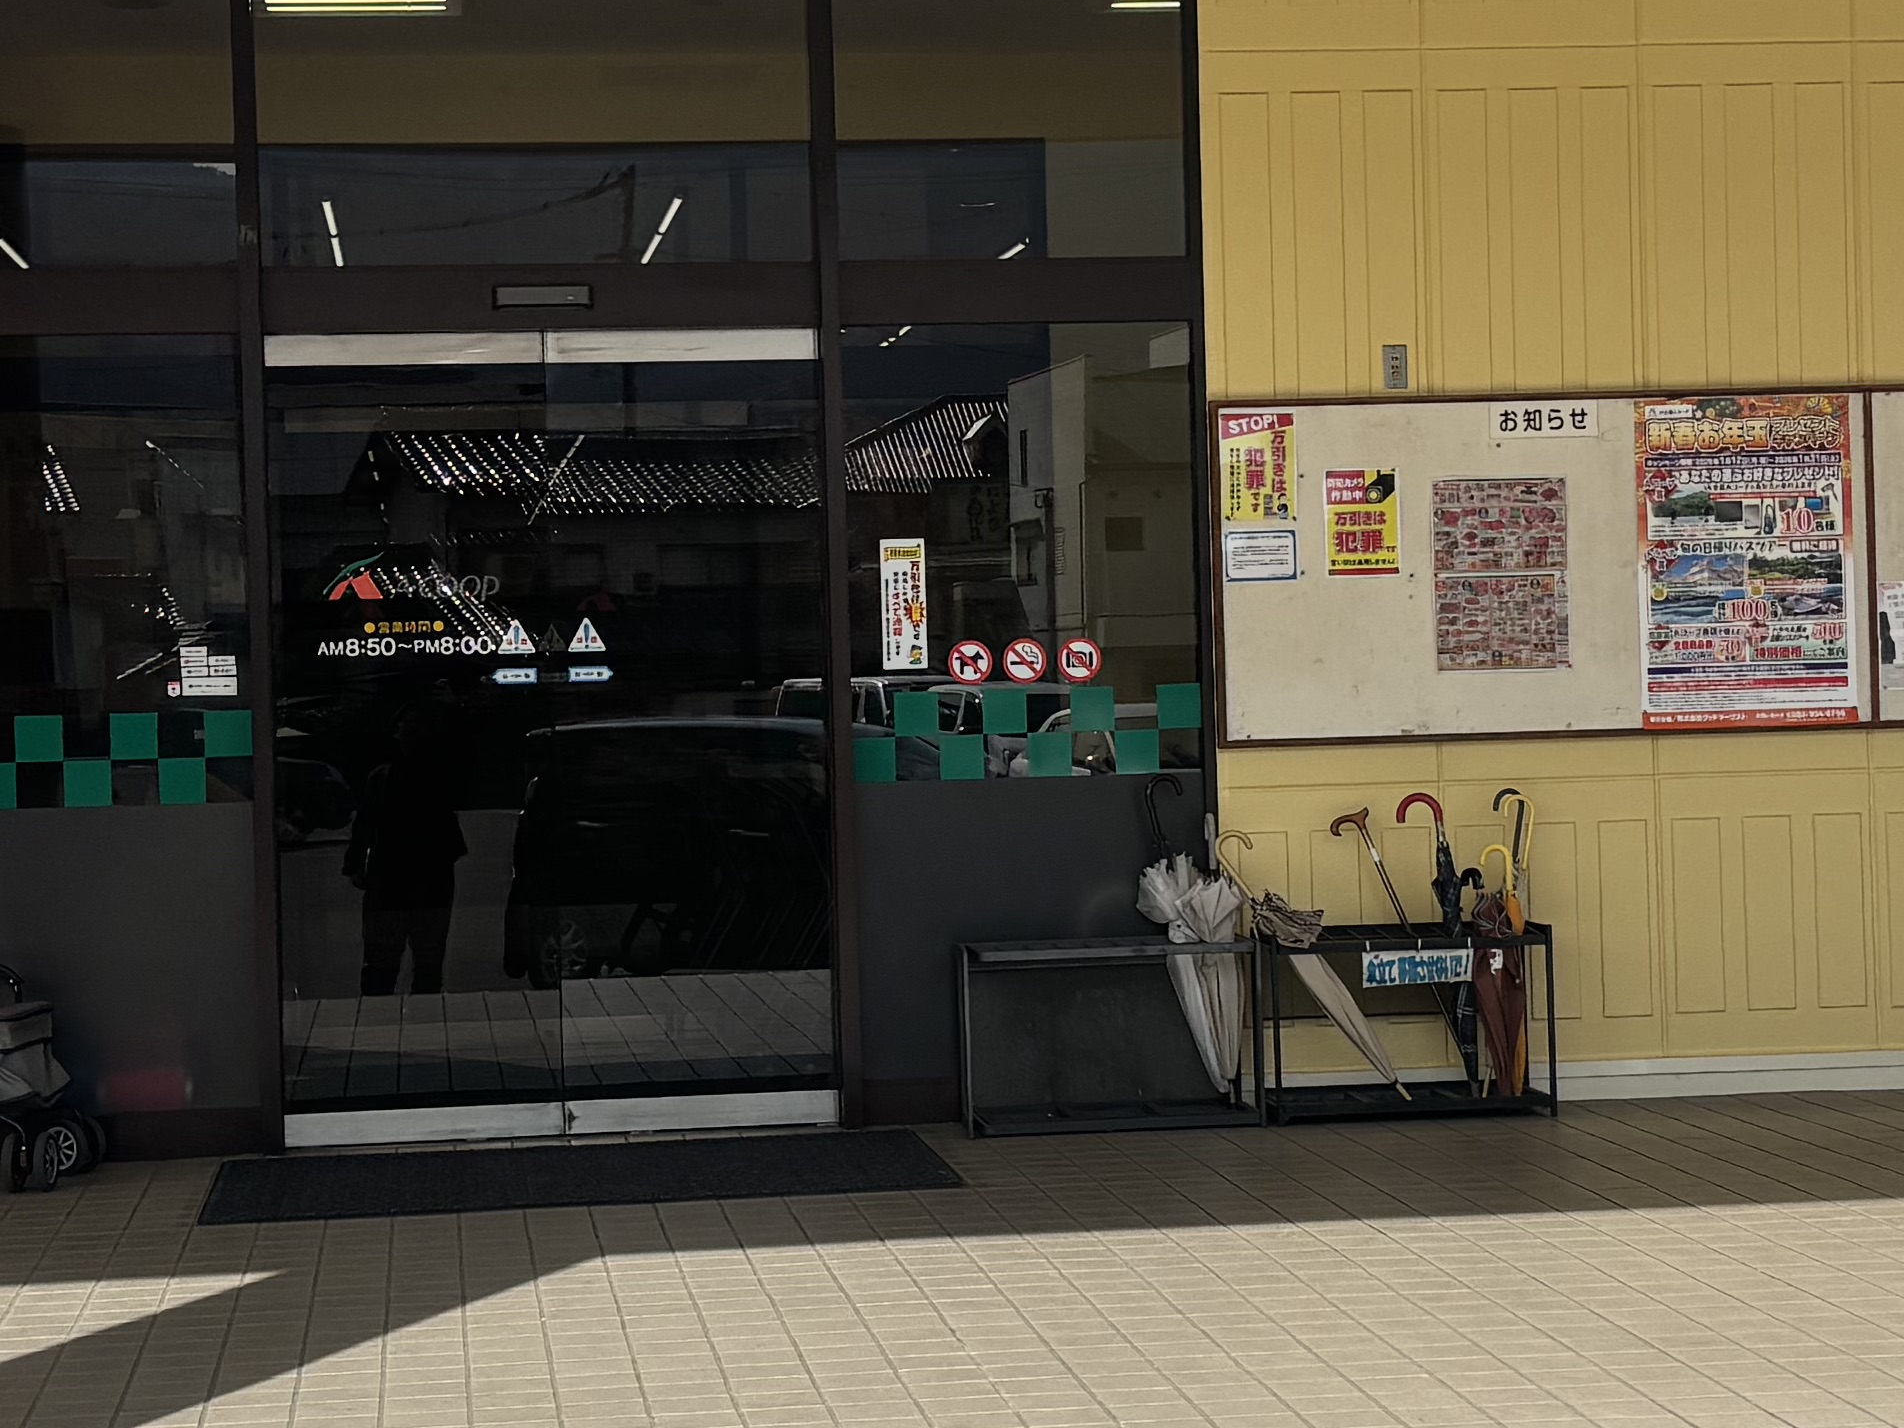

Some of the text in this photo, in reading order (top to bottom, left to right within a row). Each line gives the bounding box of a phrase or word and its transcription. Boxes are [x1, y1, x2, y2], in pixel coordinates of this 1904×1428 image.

[1228, 415, 1280, 435] STOP!
[1499, 408, 1588, 432] お知らせ
